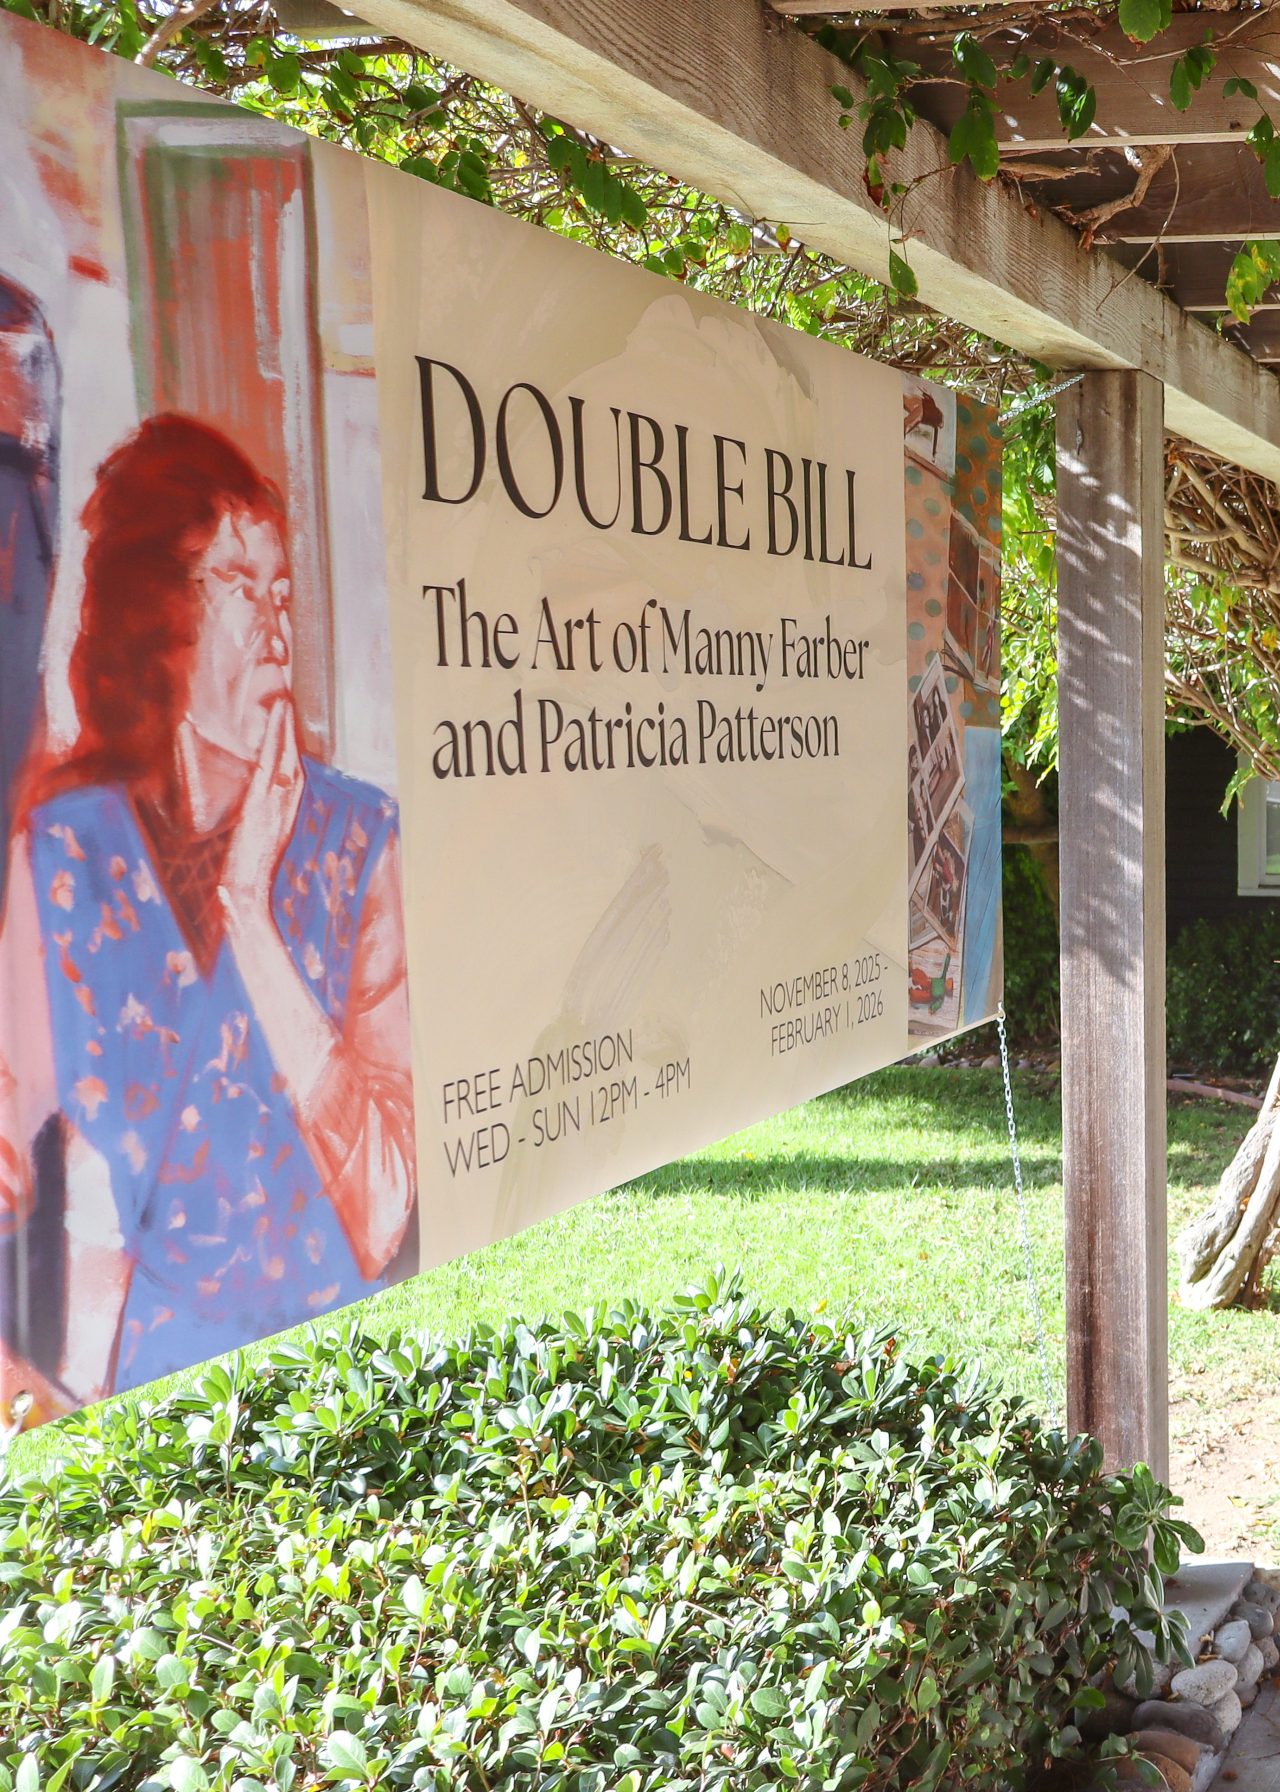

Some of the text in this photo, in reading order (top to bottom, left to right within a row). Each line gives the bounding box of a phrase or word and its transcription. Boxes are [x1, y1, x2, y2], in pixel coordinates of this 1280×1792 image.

[414, 355, 872, 569] DOUBLE BILL
[422, 577, 870, 692] The Art of Manny Farber
[432, 689, 840, 780] and Patricia Patterson
[760, 966, 839, 1018] NOVEMBER
[841, 962, 851, 993] 8,
[854, 953, 881, 987] 2025
[771, 989, 884, 1057] FEBRUARY 1, 2026
[443, 1028, 633, 1124] FREE ADMISSION
[443, 1122, 510, 1178] WED
[532, 1095, 581, 1148] SUN
[590, 1075, 638, 1126] 12PM
[655, 1056, 691, 1099] 4PM
